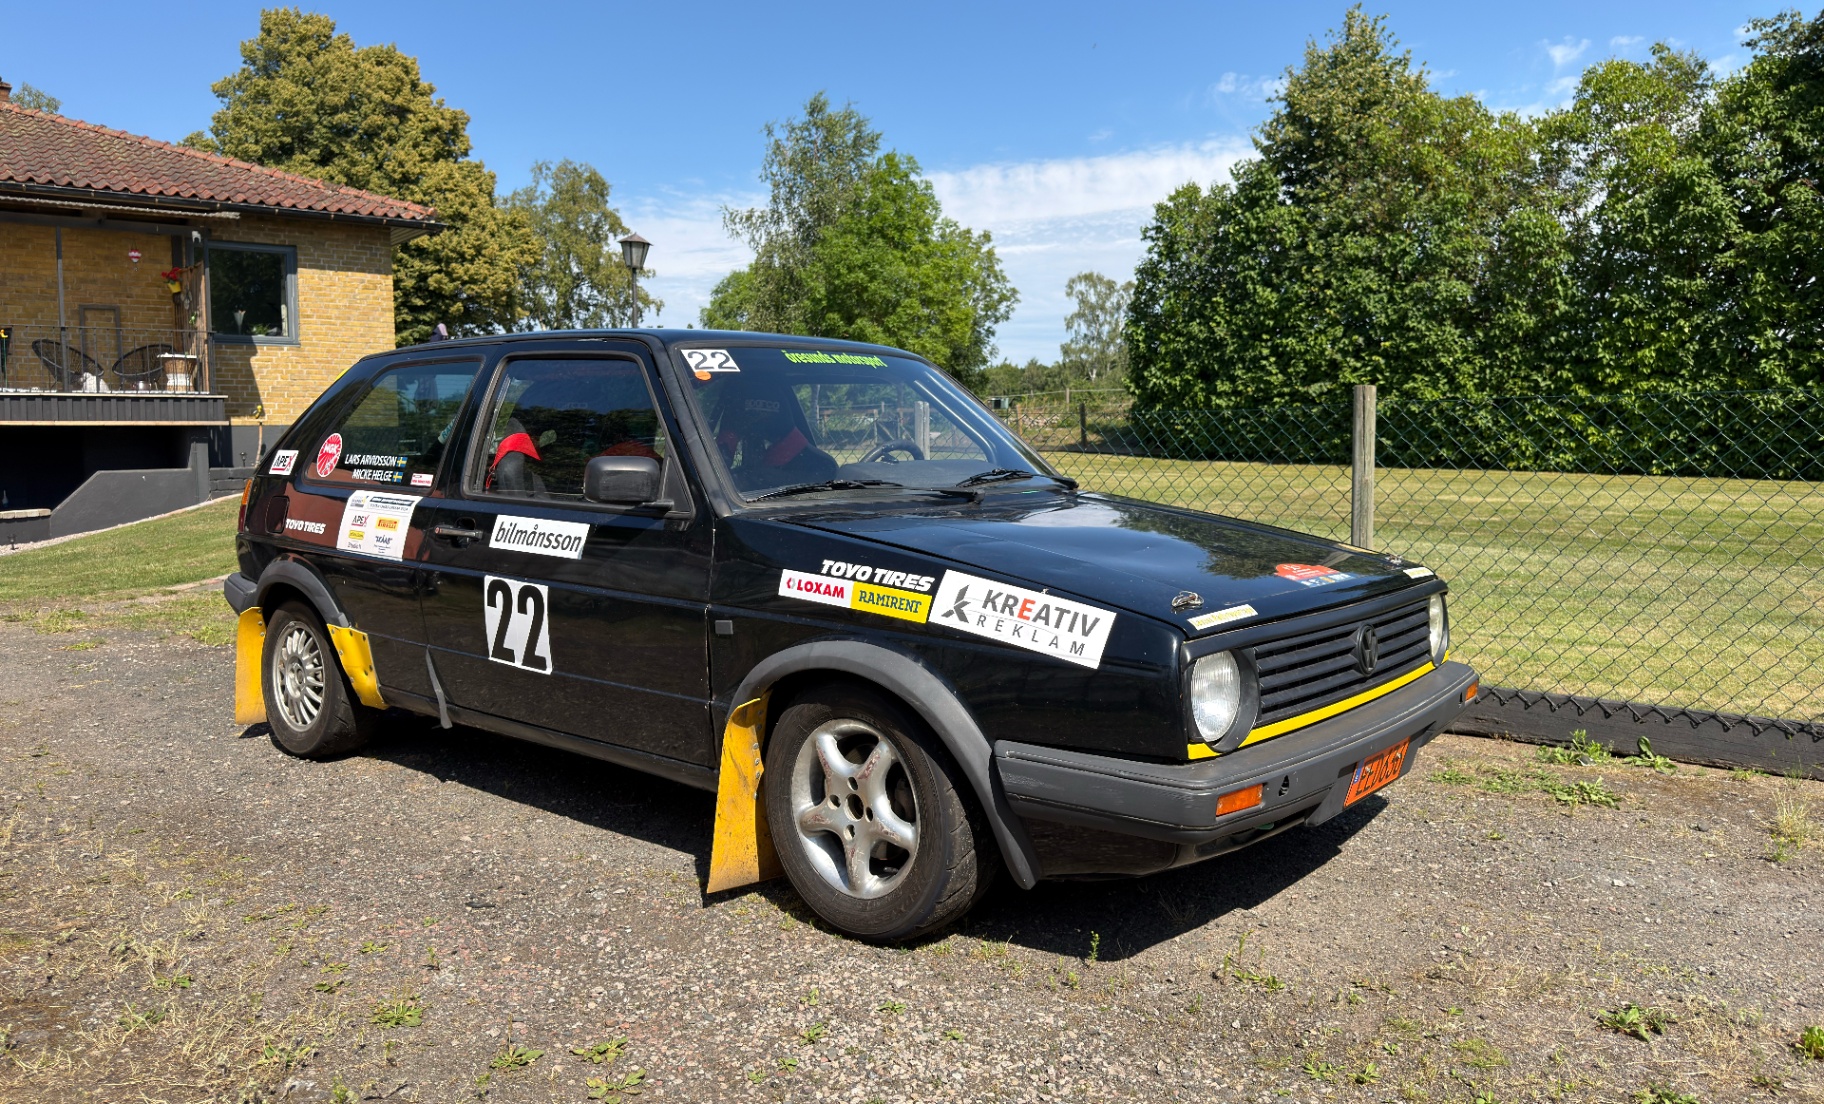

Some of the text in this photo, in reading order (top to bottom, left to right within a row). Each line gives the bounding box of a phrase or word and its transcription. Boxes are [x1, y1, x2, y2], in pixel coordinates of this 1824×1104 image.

[687, 351, 738, 370] 22
[831, 353, 888, 369] motorsport
[345, 454, 361, 465] LARS
[352, 469, 393, 482] MICKE HELGE
[285, 518, 327, 535] TOYO TIRES
[495, 521, 582, 552] bilmånsson
[820, 559, 935, 592] TOYO TIRES
[796, 579, 845, 599] LOXAM
[858, 590, 922, 614] RAMIRENT
[981, 589, 1101, 637] KREATIV
[487, 579, 548, 671] 22
[976, 614, 1086, 656] REKLAM
